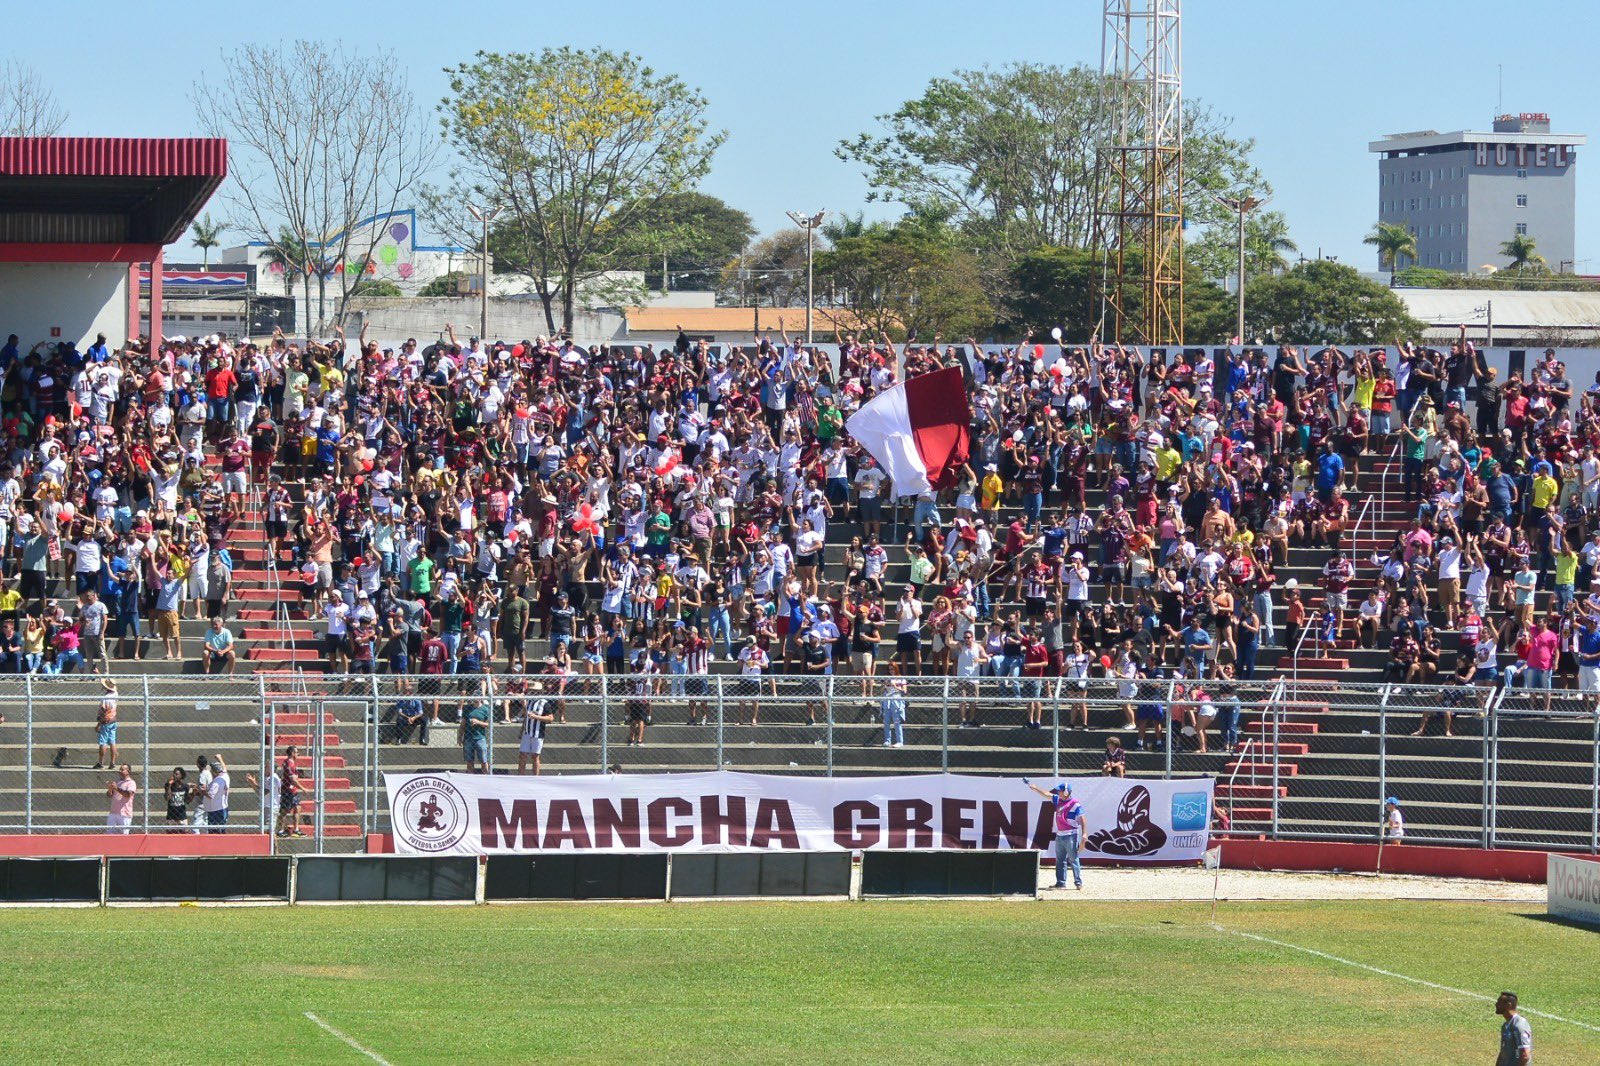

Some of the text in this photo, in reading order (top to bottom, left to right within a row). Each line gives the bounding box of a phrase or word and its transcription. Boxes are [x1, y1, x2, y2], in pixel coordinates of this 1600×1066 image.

[1520, 113, 1550, 122] HOTEL
[1476, 143, 1567, 166] HOTEL
[402, 780, 454, 796] MANCHA GRENA
[477, 795, 801, 849] MANCHA
[1173, 833, 1203, 848] UNIÃO
